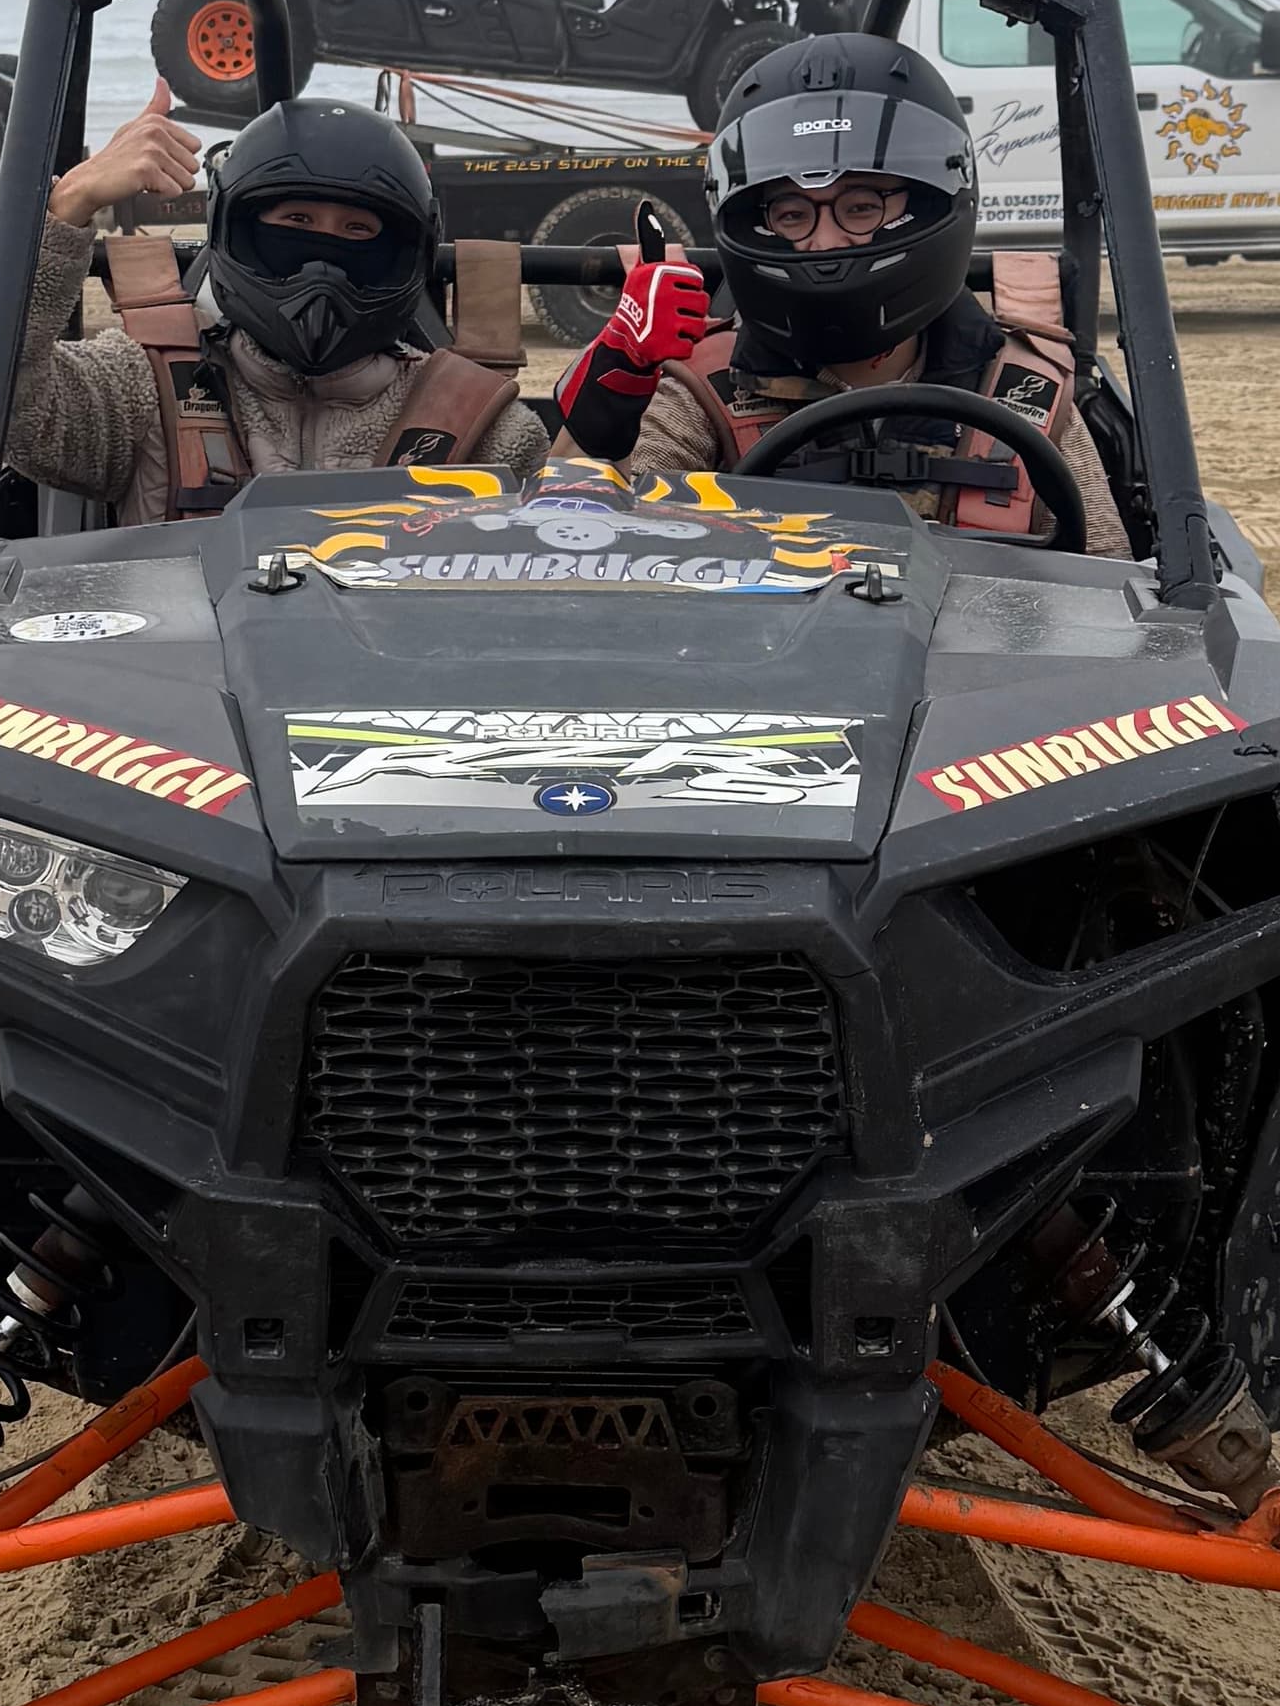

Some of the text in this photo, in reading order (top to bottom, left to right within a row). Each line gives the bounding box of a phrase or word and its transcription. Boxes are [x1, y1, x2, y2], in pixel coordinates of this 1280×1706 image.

[793, 118, 852, 135] sparco
[464, 159, 500, 173] THE
[558, 157, 617, 171] STUFF
[624, 157, 648, 169] ON
[655, 155, 690, 168] THE
[981, 196, 1000, 207] CA
[986, 211, 1013, 221] DOT
[378, 553, 774, 584] SUNBUGGY
[474, 723, 669, 741] POLARIS
[931, 694, 1236, 811] SUNBUGGY
[300, 740, 810, 798] RZR
[382, 869, 771, 904] POLARIS
